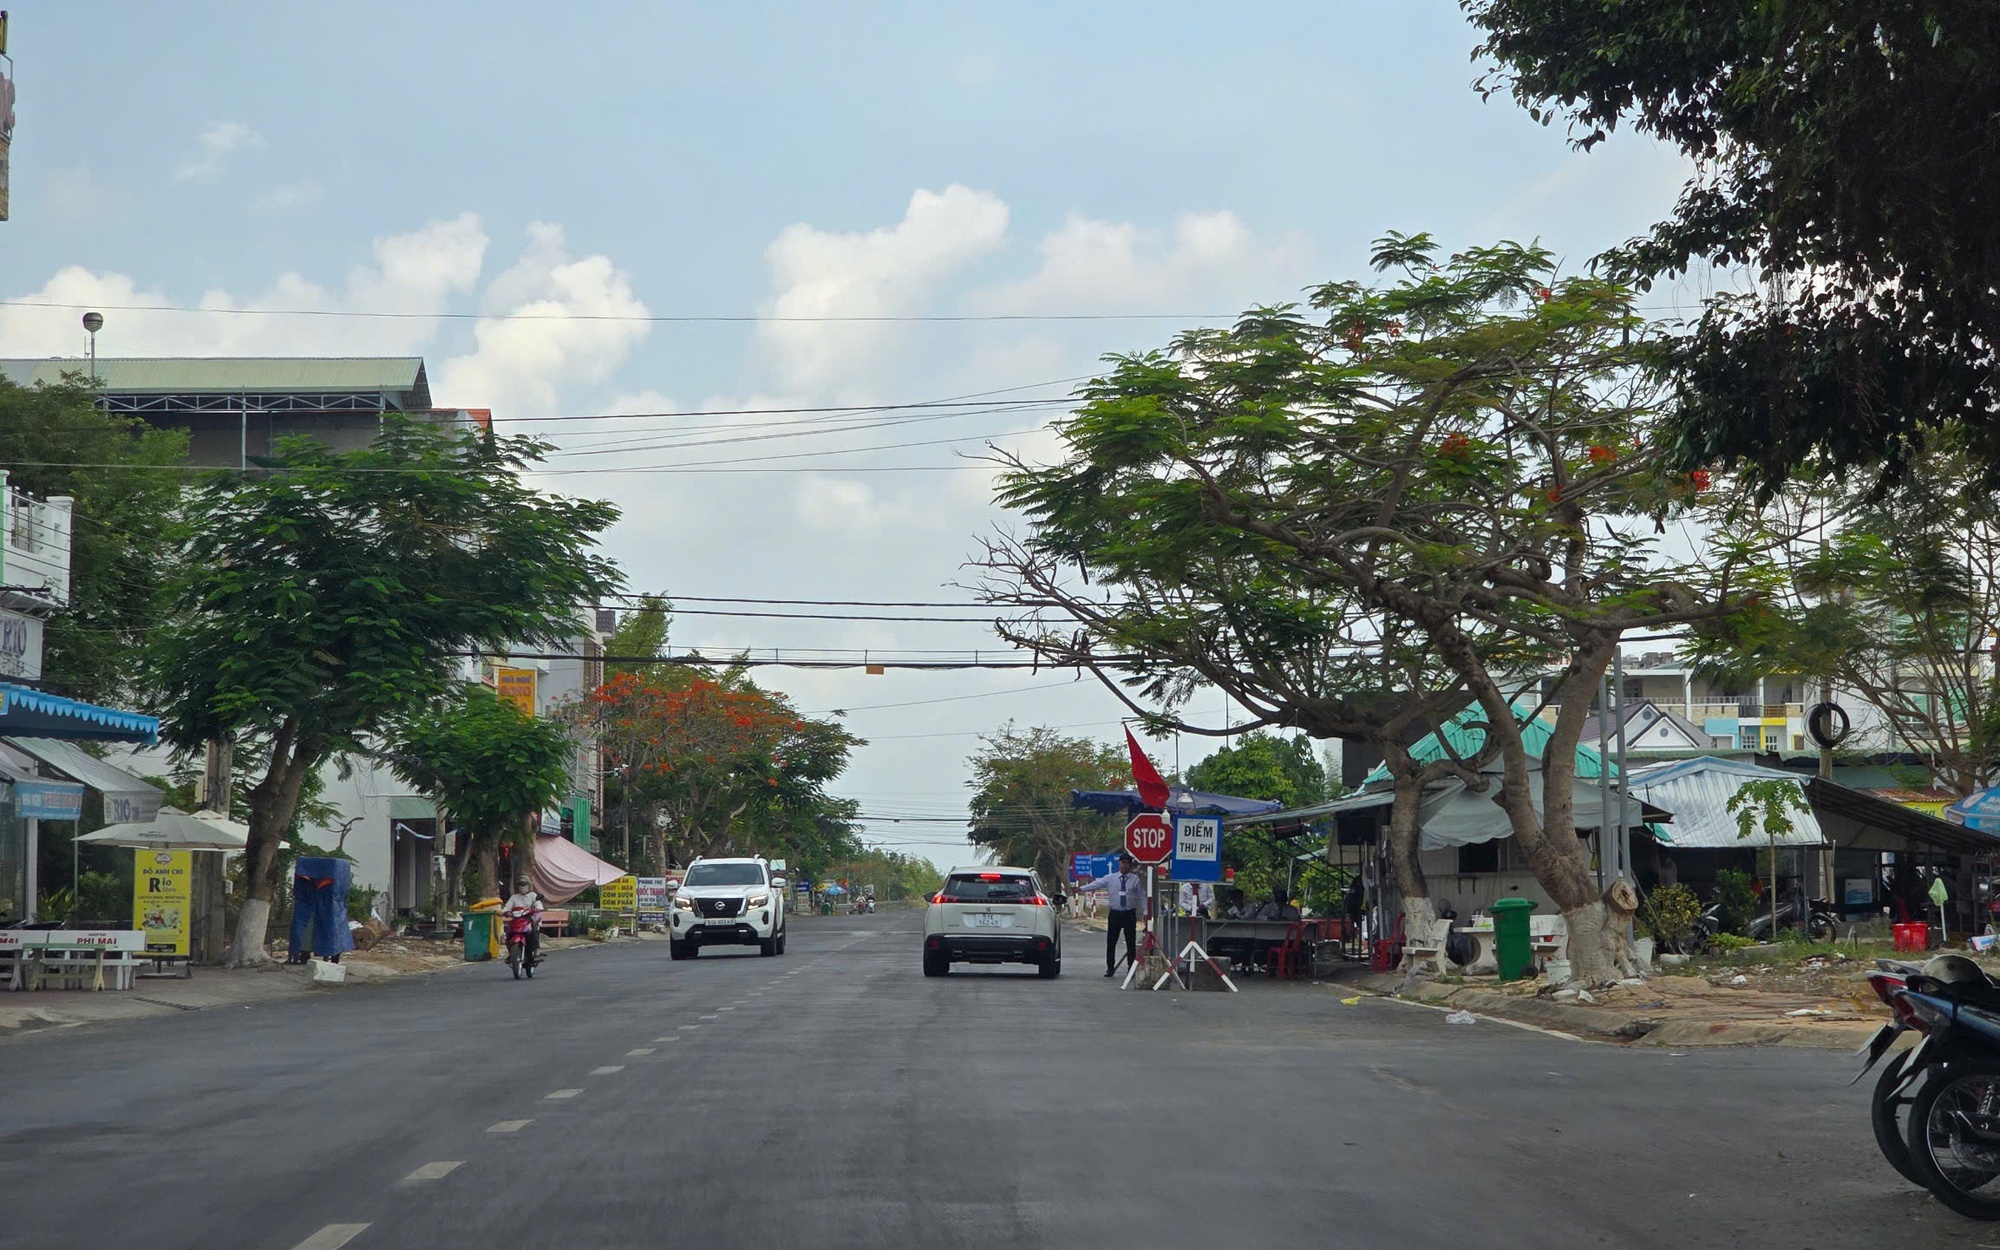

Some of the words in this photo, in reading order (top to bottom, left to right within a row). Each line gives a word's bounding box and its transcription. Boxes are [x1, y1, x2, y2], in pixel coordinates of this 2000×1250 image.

[1184, 821, 1213, 838] ĐIỂM
[1133, 828, 1166, 849] STOP
[1179, 842, 1197, 853] THU
[1199, 842, 1214, 854] PHÍ
